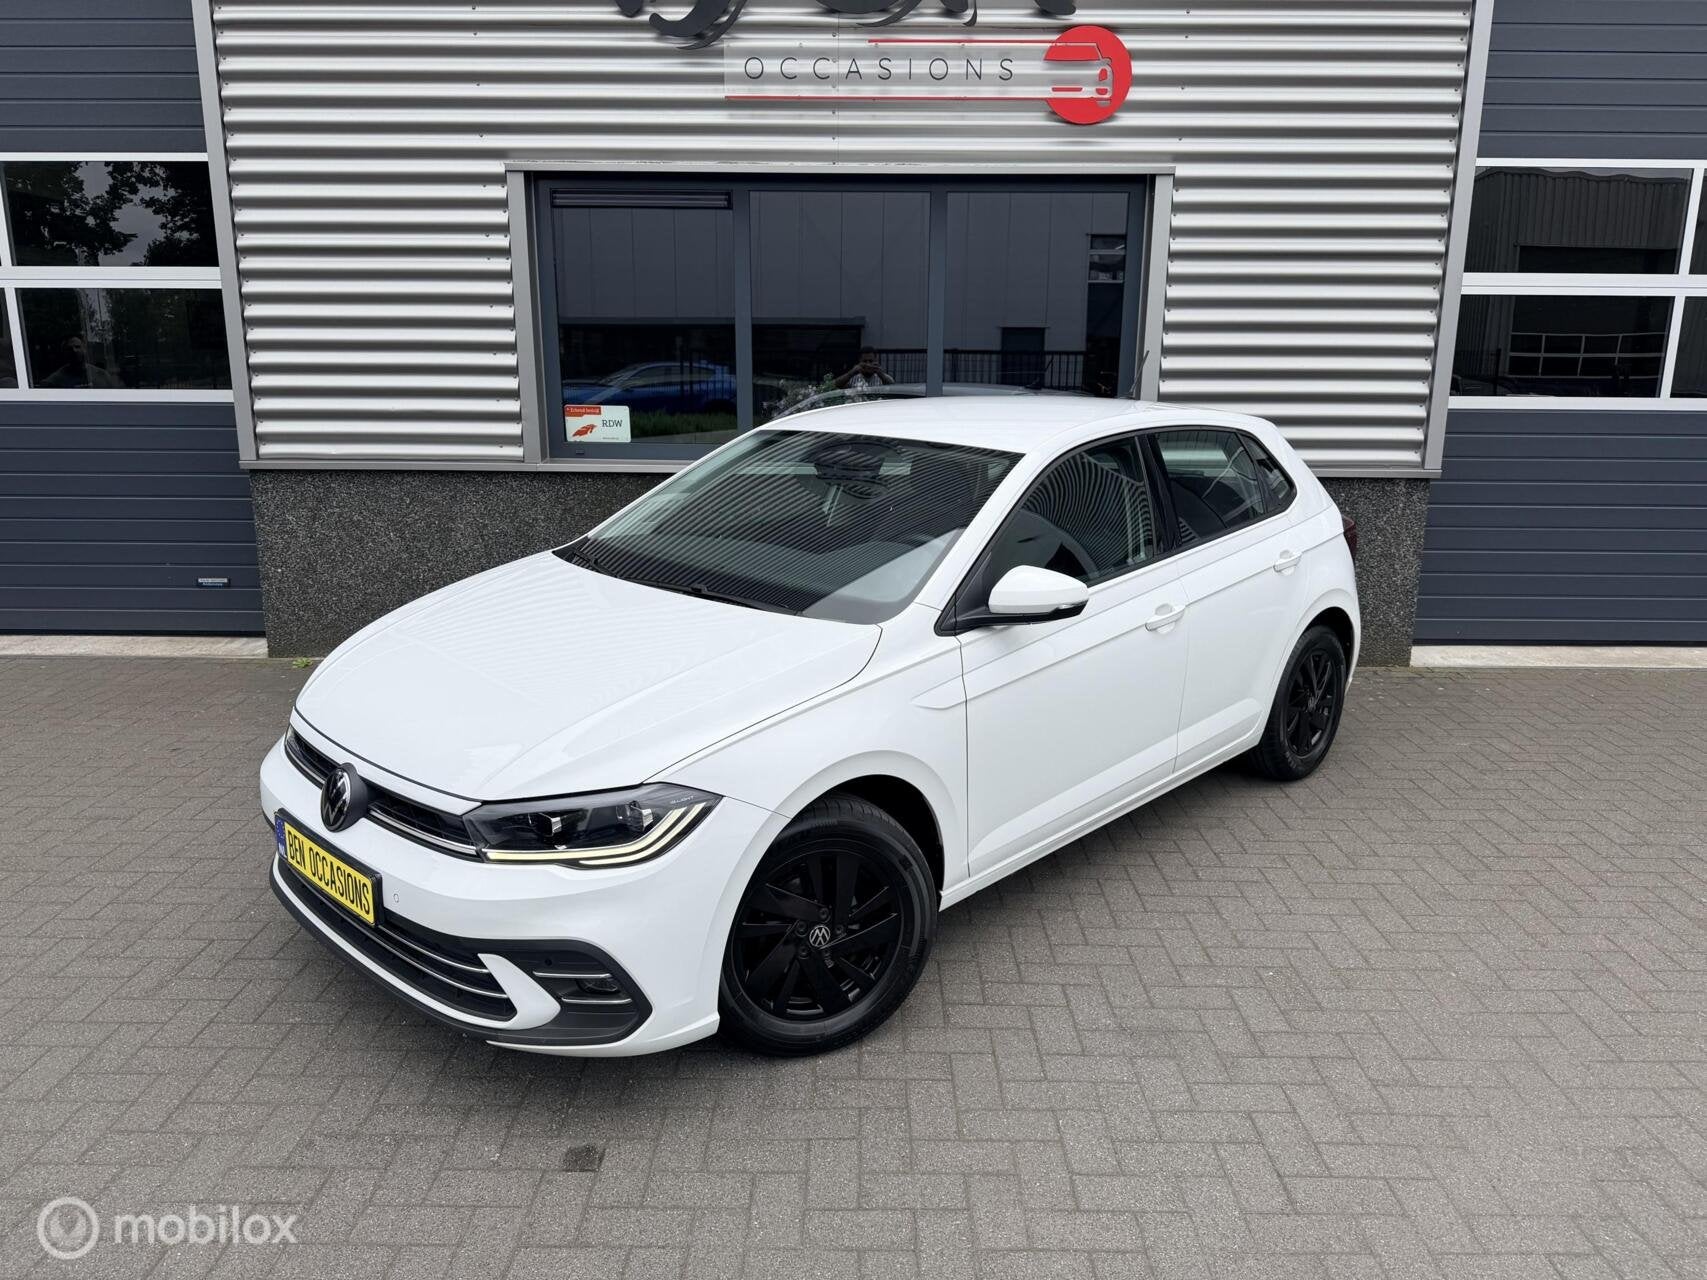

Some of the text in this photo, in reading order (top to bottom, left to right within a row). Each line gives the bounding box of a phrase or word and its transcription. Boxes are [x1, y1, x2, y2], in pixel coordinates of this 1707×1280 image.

[743, 56, 1015, 82] OCCASIONS
[601, 419, 623, 428] RDW
[287, 829, 371, 916] BEN OCCASIONS
